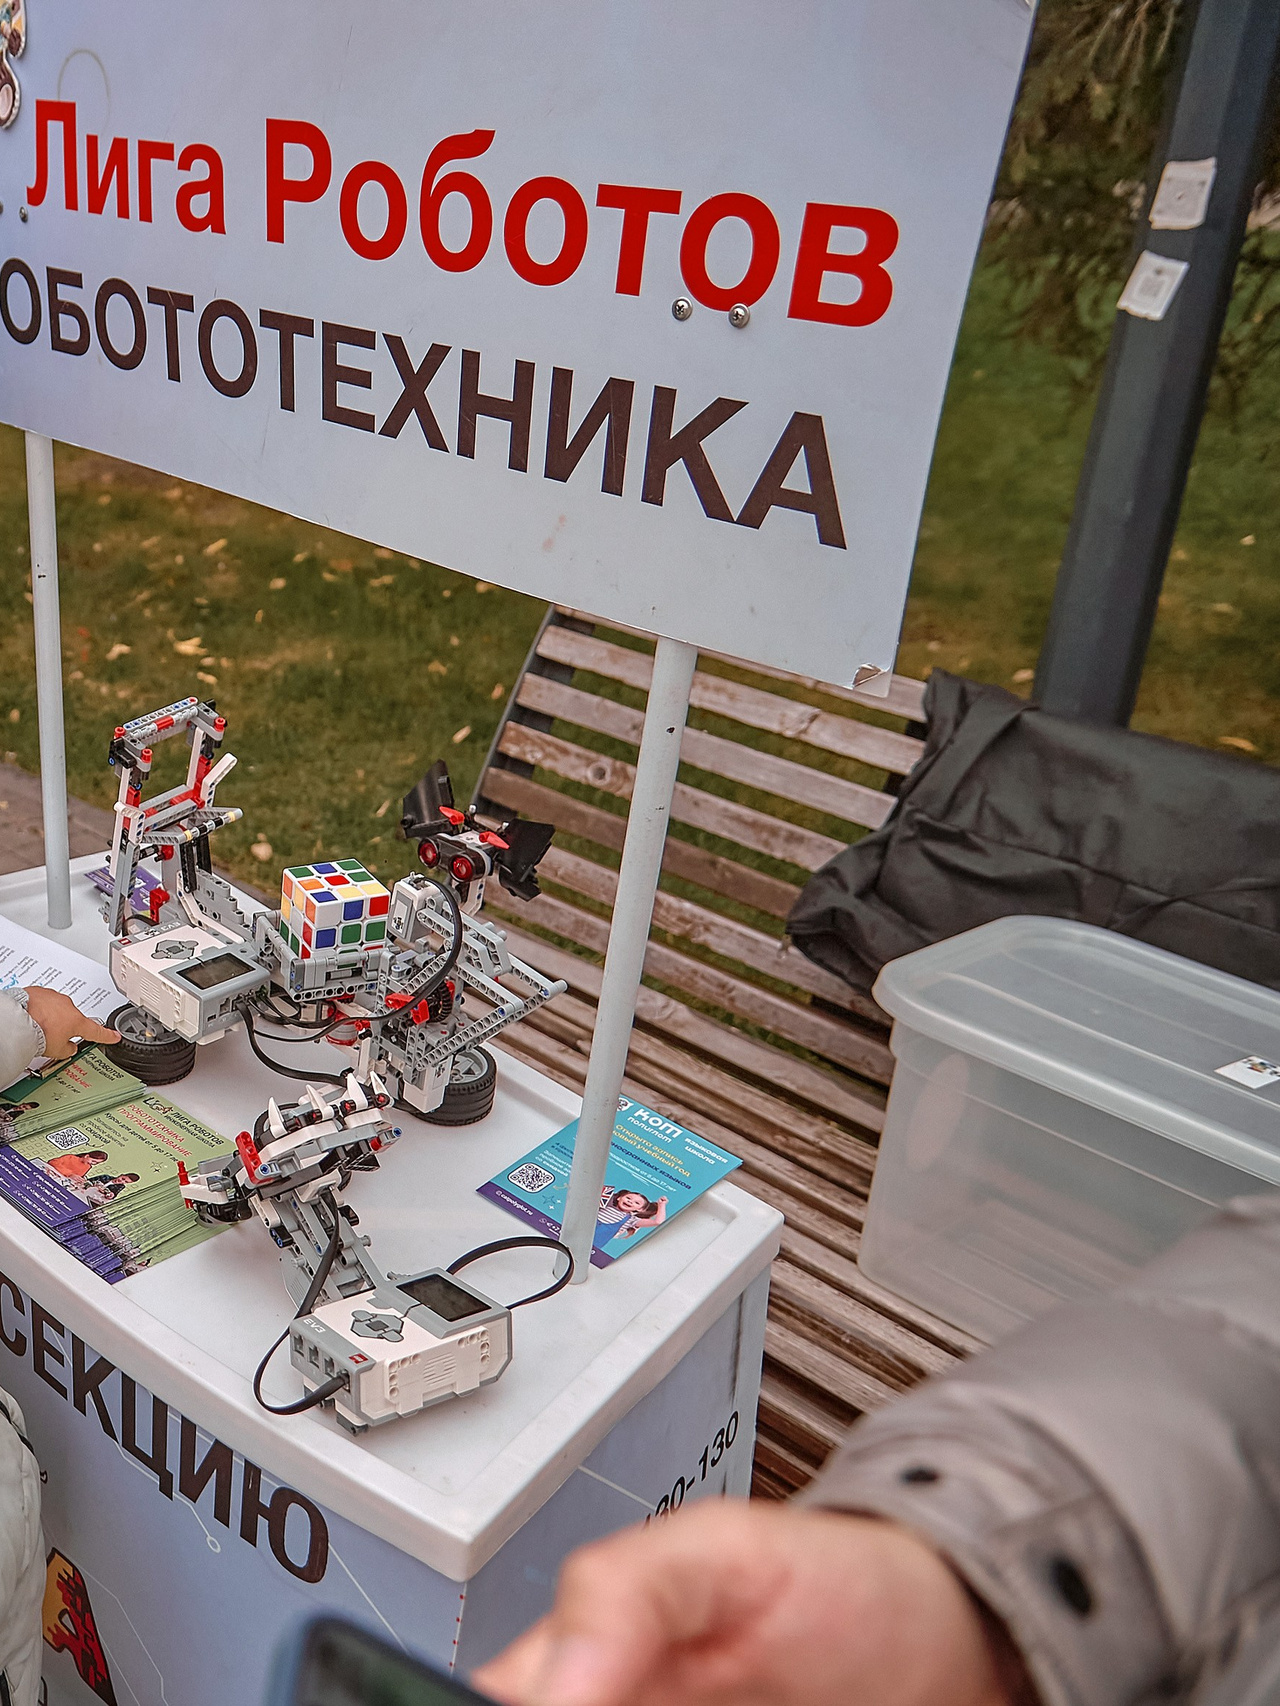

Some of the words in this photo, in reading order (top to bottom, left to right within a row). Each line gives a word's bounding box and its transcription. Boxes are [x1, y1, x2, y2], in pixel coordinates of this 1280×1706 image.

[26, 99, 226, 235] Лига
[265, 118, 900, 328] Роботов
[117, 1107, 192, 1157] ПРОГРАММИРОВАНИЕ
[127, 1104, 185, 1143] РОБОТОТЕХНИКА
[171, 1111, 191, 1125] ЛИГА
[189, 1123, 224, 1145] РОБОТОВ
[627, 1116, 672, 1144] полиглот
[615, 1124, 653, 1150] Открыта
[652, 1144, 684, 1165] запись
[635, 1143, 676, 1169] учебный
[674, 1164, 691, 1178] год
[684, 1138, 729, 1164] языковая
[684, 1146, 716, 1165] школа
[659, 1170, 692, 1190] языков
[303, 1318, 326, 1333] EV3
